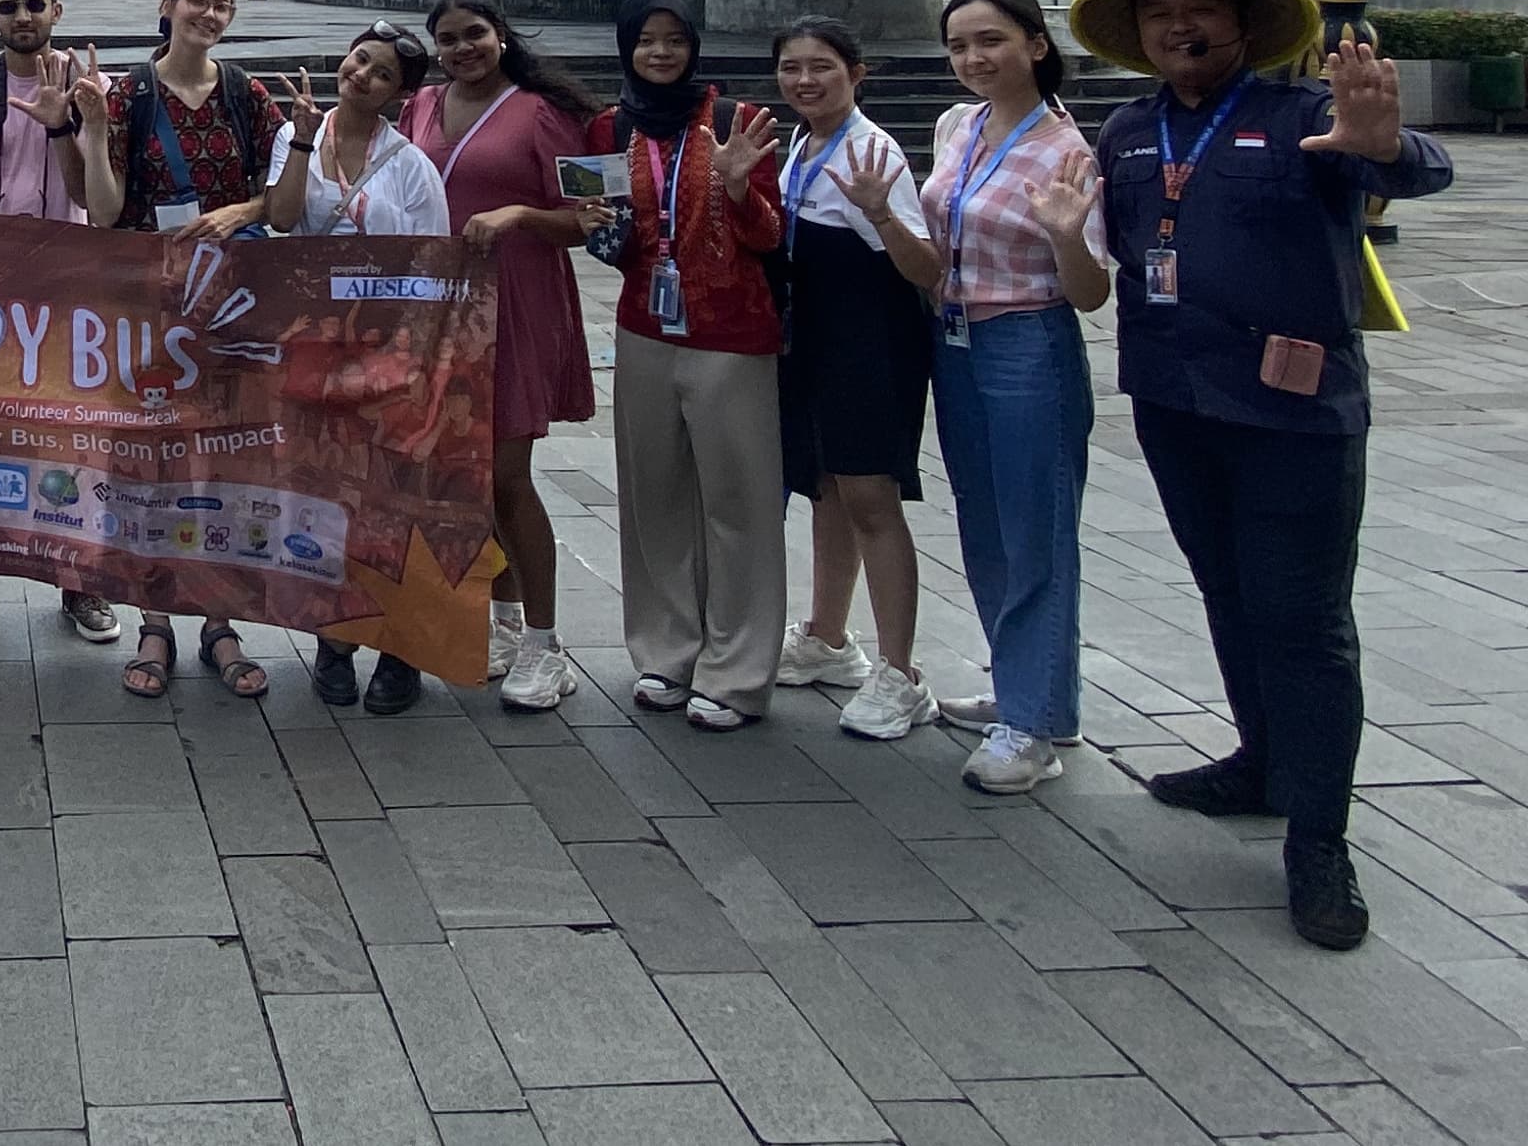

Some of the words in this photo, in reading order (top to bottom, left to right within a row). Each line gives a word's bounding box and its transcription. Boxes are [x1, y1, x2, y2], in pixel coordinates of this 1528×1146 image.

[370, 264, 383, 275] by
[344, 278, 428, 298] AIESEC
[71, 307, 201, 393] BUS
[75, 405, 141, 424] Summer
[145, 410, 182, 425] Peak
[12, 428, 64, 452] Bus,
[72, 432, 154, 462] Bloom
[161, 441, 186, 460] to
[194, 422, 286, 455] Impact
[33, 508, 84, 529] Institut
